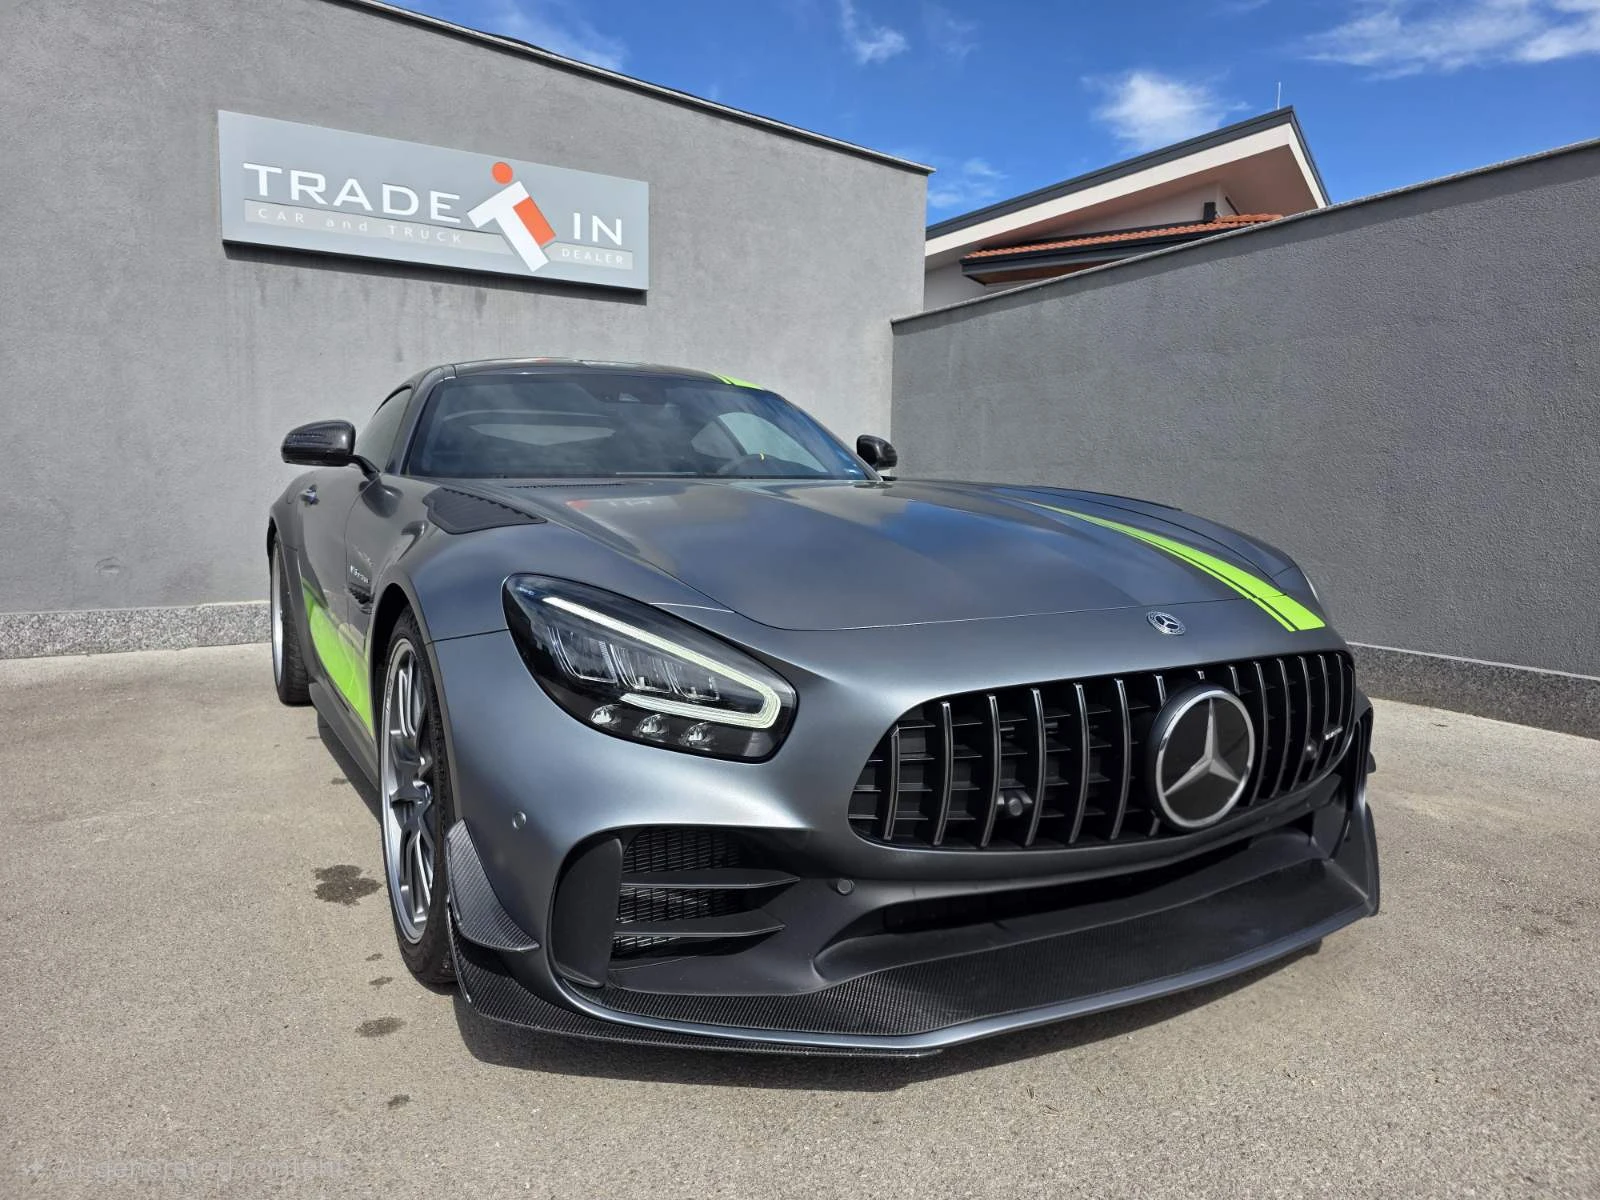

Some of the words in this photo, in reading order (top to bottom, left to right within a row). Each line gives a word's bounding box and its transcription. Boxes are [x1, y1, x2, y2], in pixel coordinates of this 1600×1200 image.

[243, 162, 461, 224] TRADE
[573, 212, 623, 246] IN
[258, 207, 304, 224] CAR
[325, 217, 368, 232] and
[388, 224, 463, 244] TRUCK
[562, 249, 625, 265] DEALER
